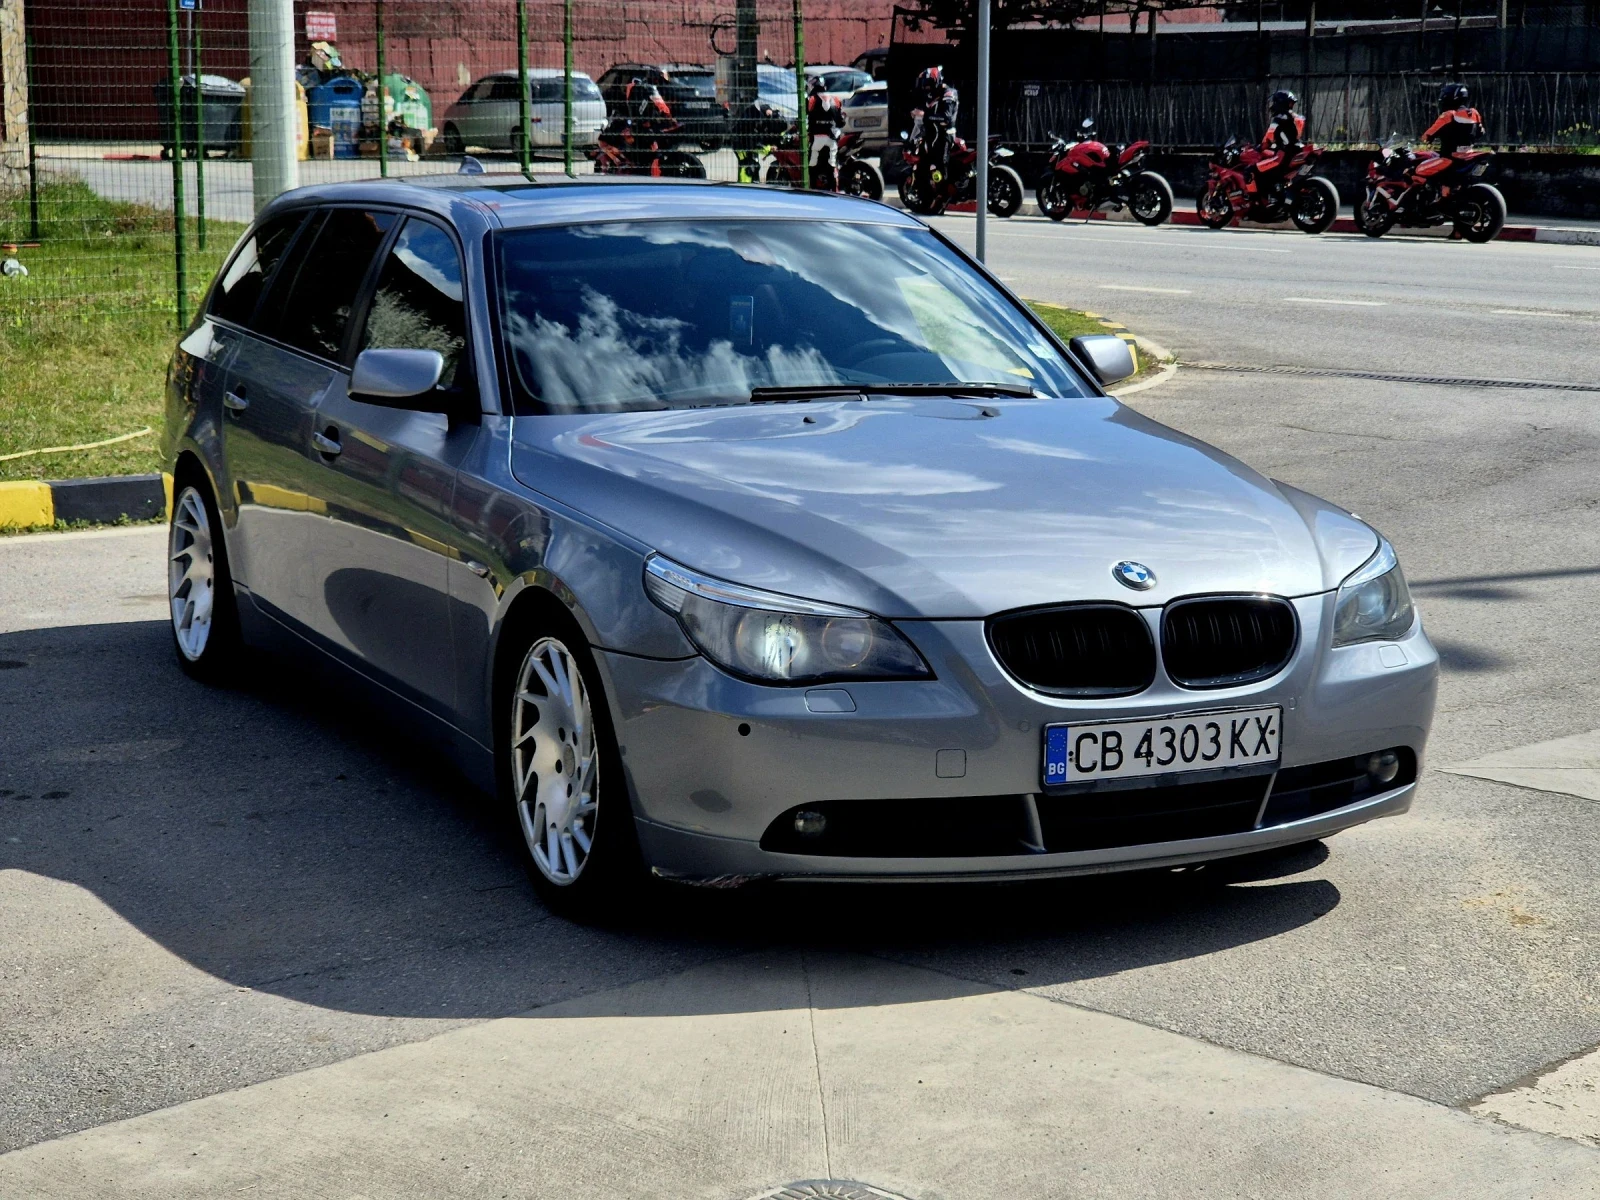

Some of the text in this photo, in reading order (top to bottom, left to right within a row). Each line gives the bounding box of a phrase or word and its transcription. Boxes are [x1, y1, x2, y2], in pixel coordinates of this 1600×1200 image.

[1075, 715, 1273, 773] CB 4303 KX
[1048, 762, 1065, 775] BG
